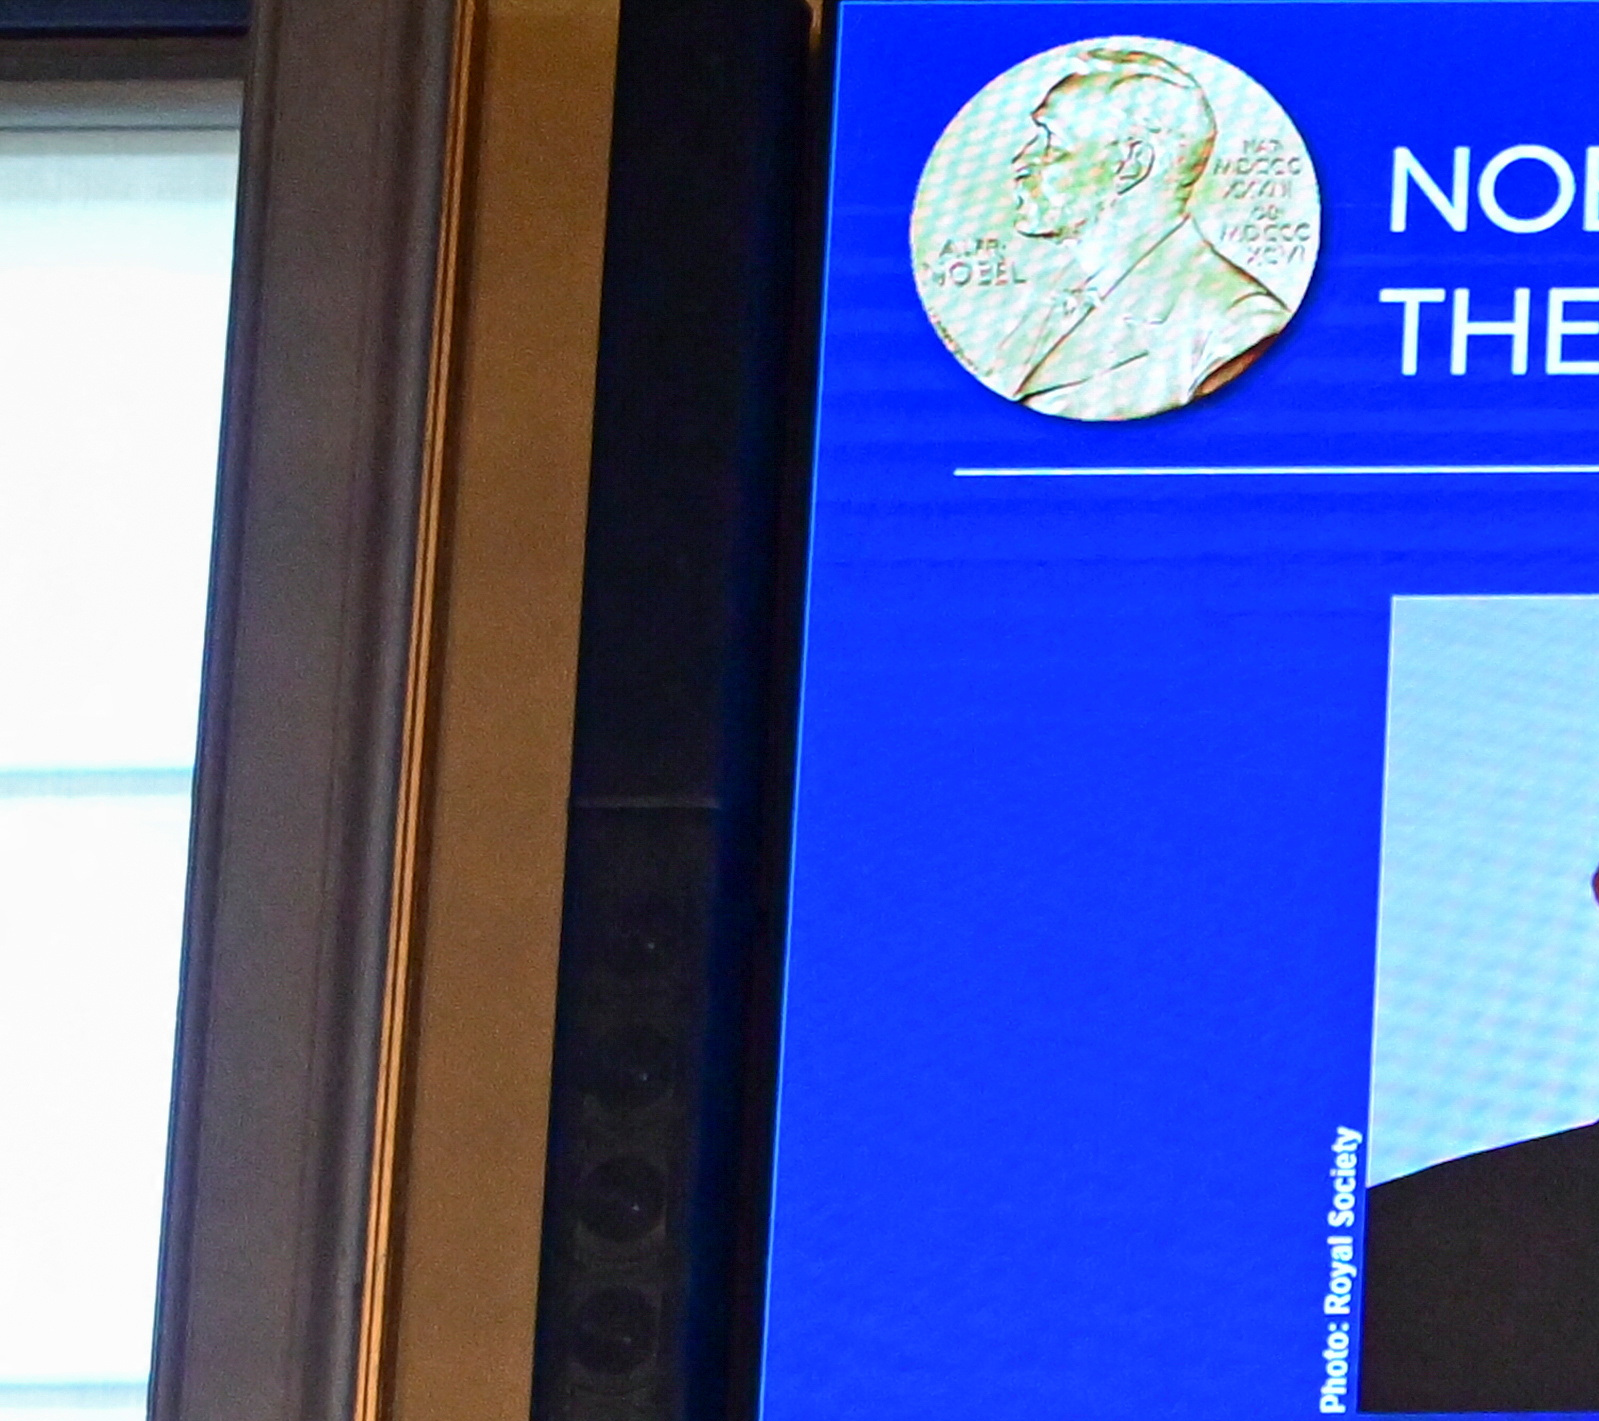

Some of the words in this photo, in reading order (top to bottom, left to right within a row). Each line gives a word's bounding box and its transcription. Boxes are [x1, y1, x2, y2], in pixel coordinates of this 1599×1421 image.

[1328, 1127, 1362, 1226] Society
[1324, 1237, 1356, 1314] Royal
[1320, 1324, 1348, 1412] Photo:
